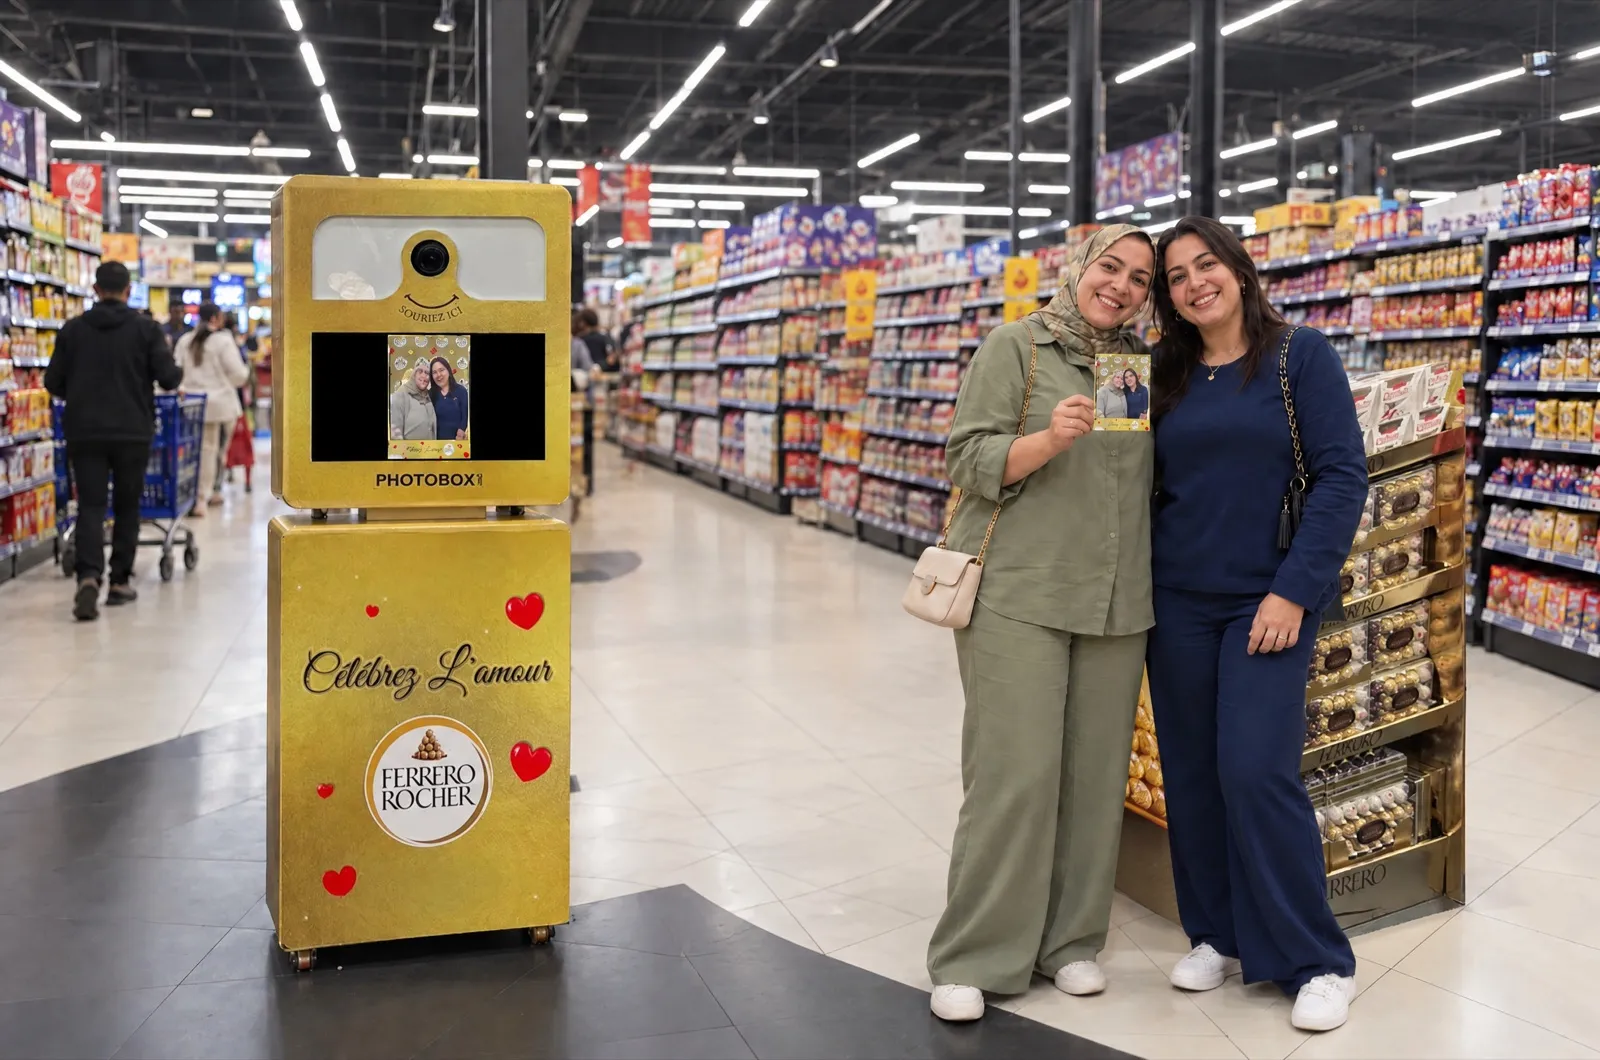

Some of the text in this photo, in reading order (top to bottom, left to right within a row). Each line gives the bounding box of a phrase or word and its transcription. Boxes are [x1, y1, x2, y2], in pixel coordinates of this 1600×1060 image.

[398, 305, 464, 323] SOURIEZ ICI
[376, 473, 475, 487] PHOTOBOX
[303, 643, 554, 700] Célébrez L'amour
[382, 763, 476, 789] FERRERO
[382, 785, 476, 811] ROCHER
[1326, 863, 1387, 900] RRERO
